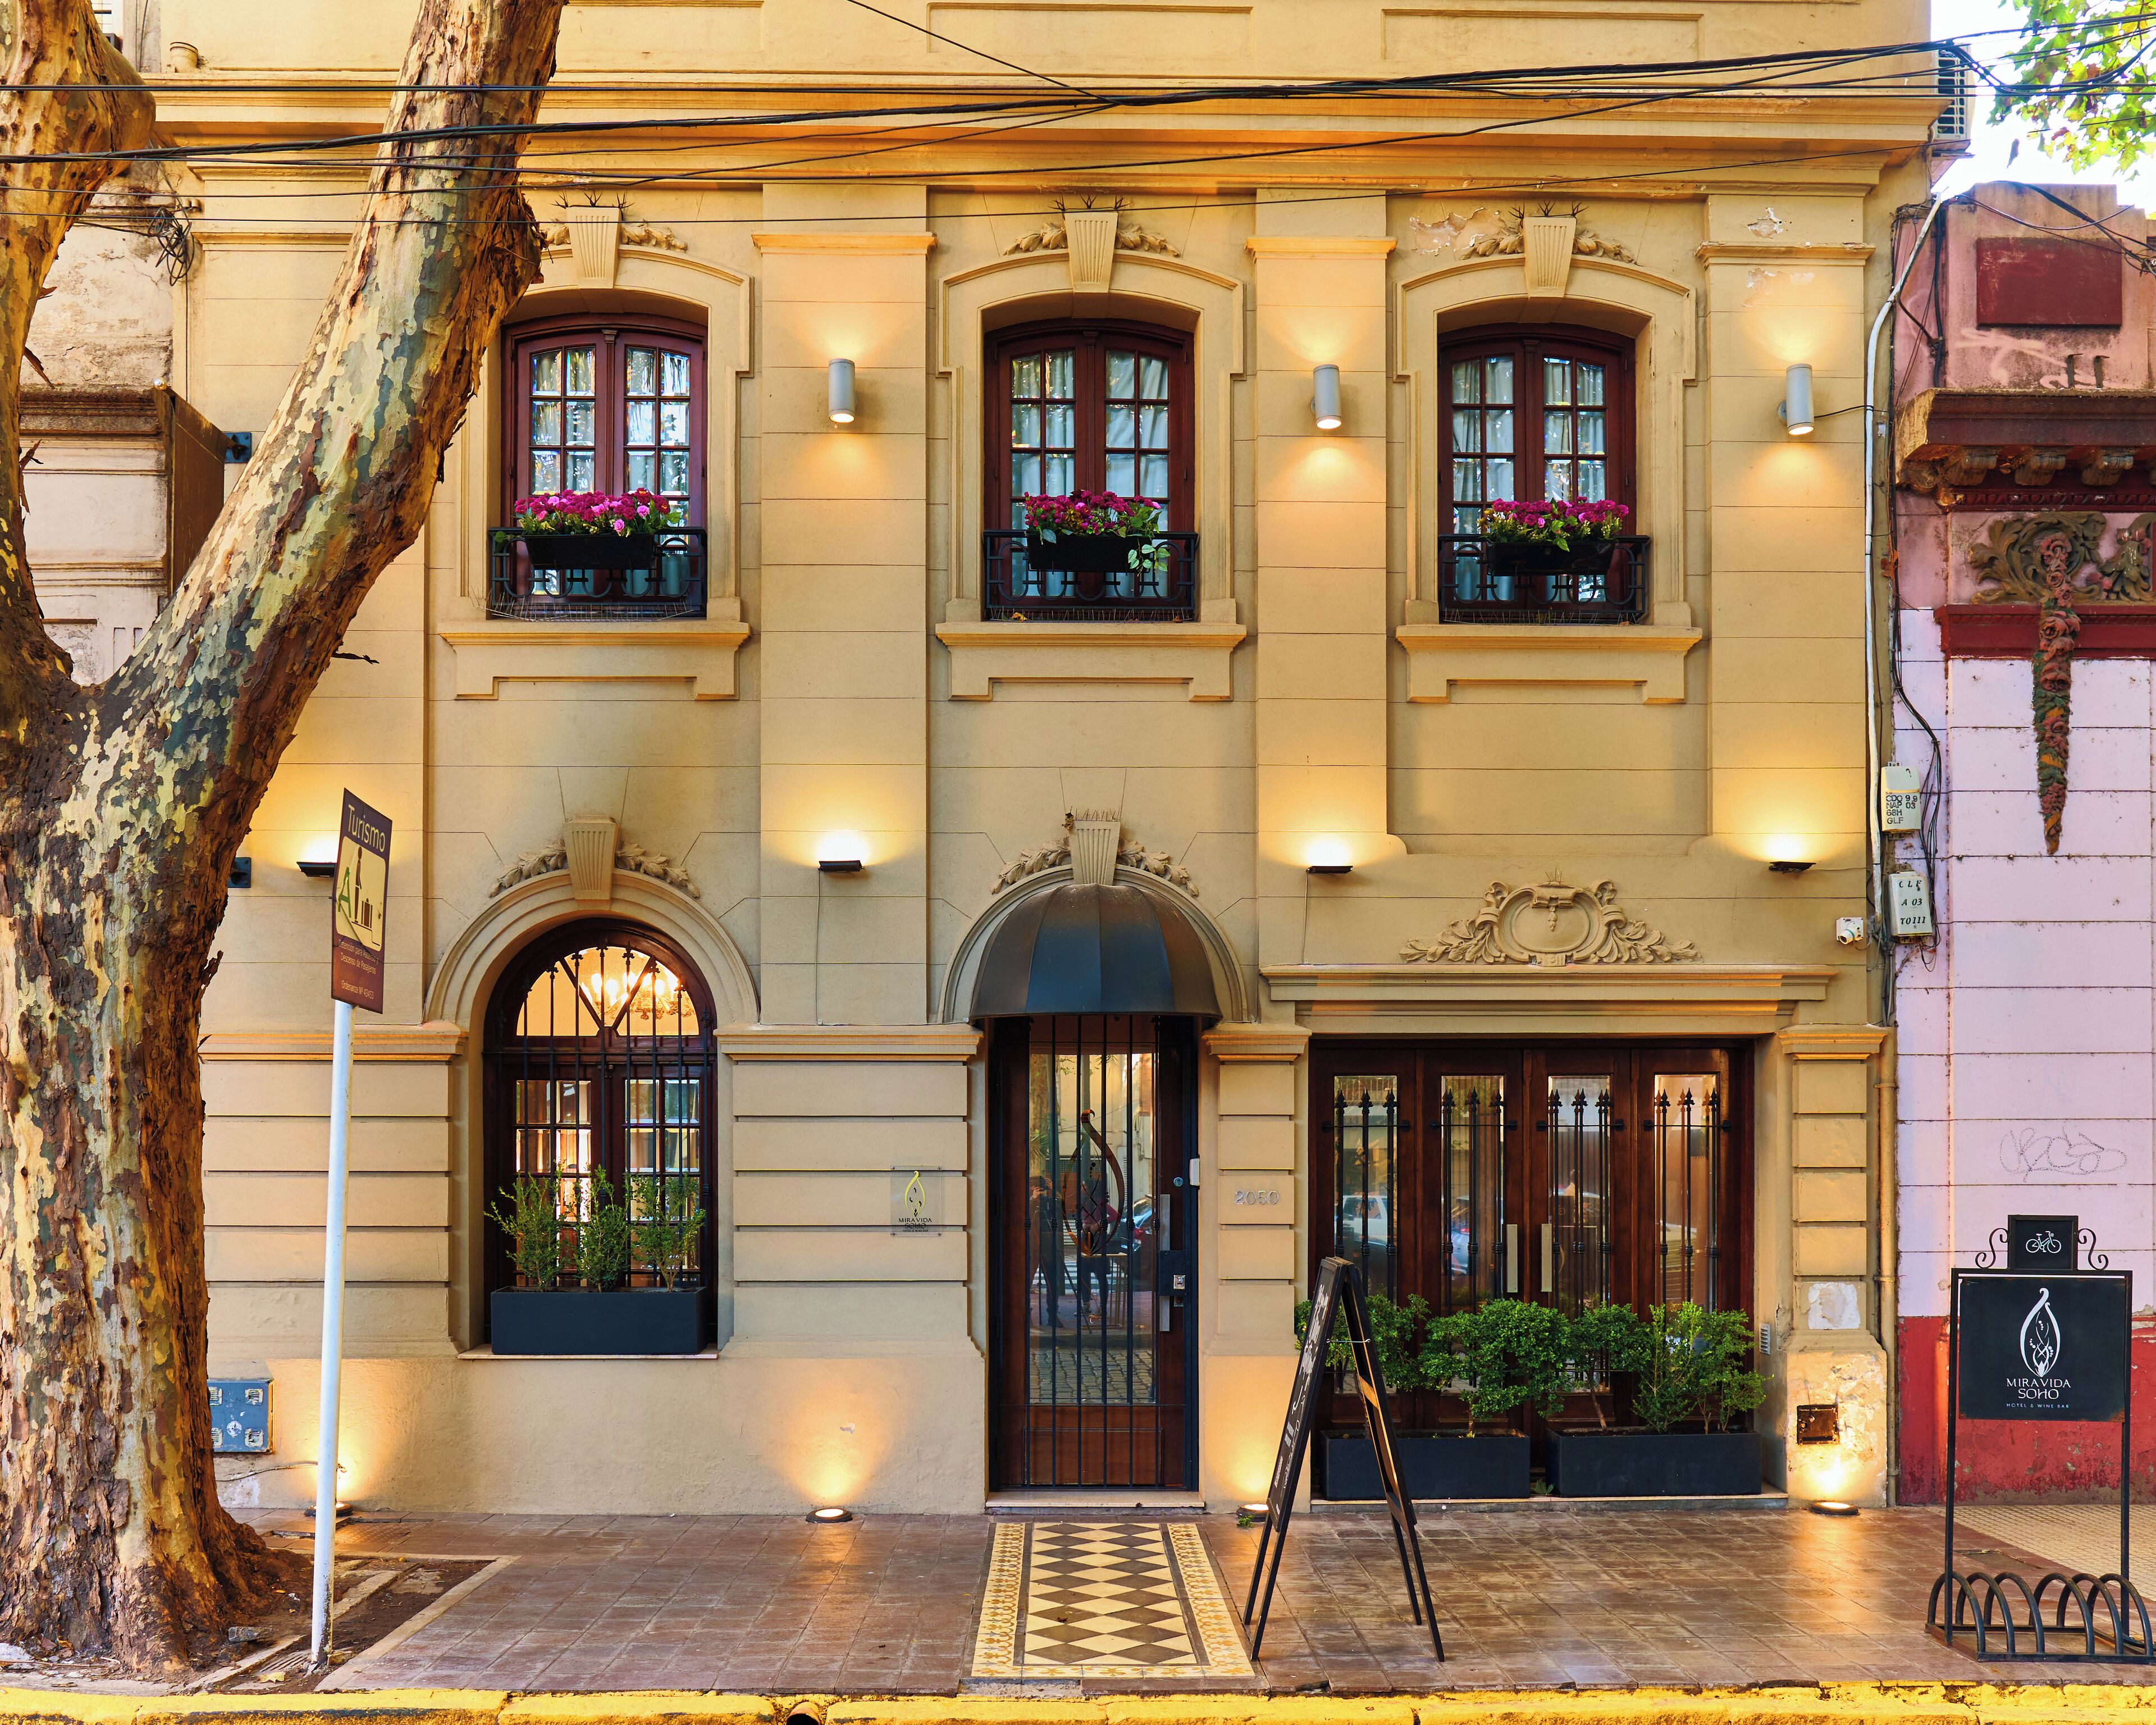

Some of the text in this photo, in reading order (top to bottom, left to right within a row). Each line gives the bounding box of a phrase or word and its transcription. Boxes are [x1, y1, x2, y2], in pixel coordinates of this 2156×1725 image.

[348, 804, 385, 852] Turismo
[341, 952, 376, 974] Descenso de Pasajeros
[341, 980, 358, 993] Ordenanza
[1235, 1190, 1280, 1205] 2050
[2006, 1378, 2071, 1388] MIRAVIDA
[2018, 1388, 2059, 1399] SOHO
